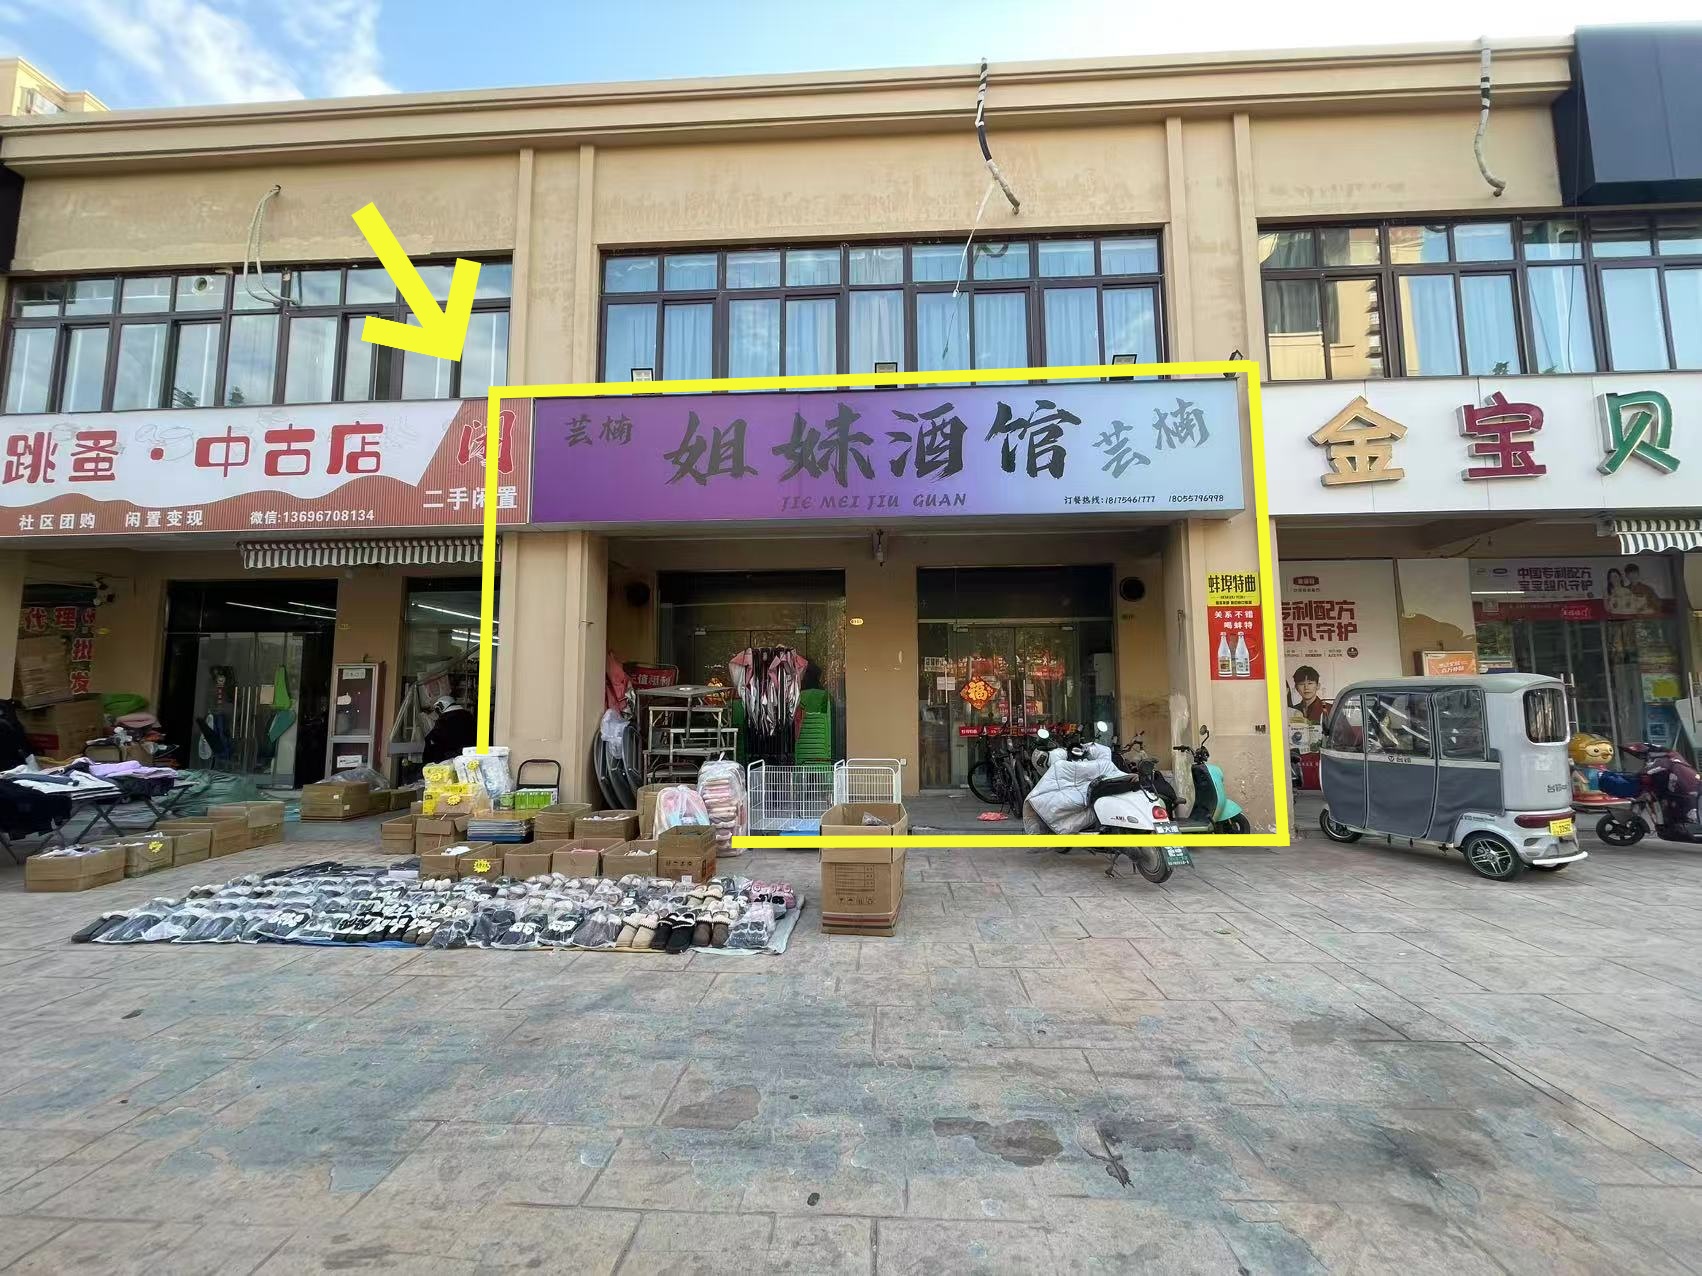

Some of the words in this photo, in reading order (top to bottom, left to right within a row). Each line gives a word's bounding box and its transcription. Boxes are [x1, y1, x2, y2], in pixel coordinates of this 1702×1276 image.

[663, 399, 1082, 488] 姐妹酒馆
[1307, 390, 1681, 487] 金宝贝
[422, 485, 518, 511] 二手闲置
[781, 495, 813, 513] JIE
[819, 494, 860, 511] MEI
[866, 494, 900, 510] JIU
[912, 493, 967, 509] GUAN
[1168, 494, 1224, 503] 18055796998
[18, 513, 96, 531] 社区团购
[125, 510, 204, 528] 闲置变现
[250, 510, 375, 525] 微信:13696708134
[1517, 566, 1592, 579] 中国专利配方
[1208, 574, 1256, 593] 蚌埠特曲
[1519, 580, 1593, 592] 宝宝超凡守护
[1214, 610, 1254, 619] 关系不错
[1223, 621, 1253, 630] 喝蚌特
[968, 681, 988, 701] 福
